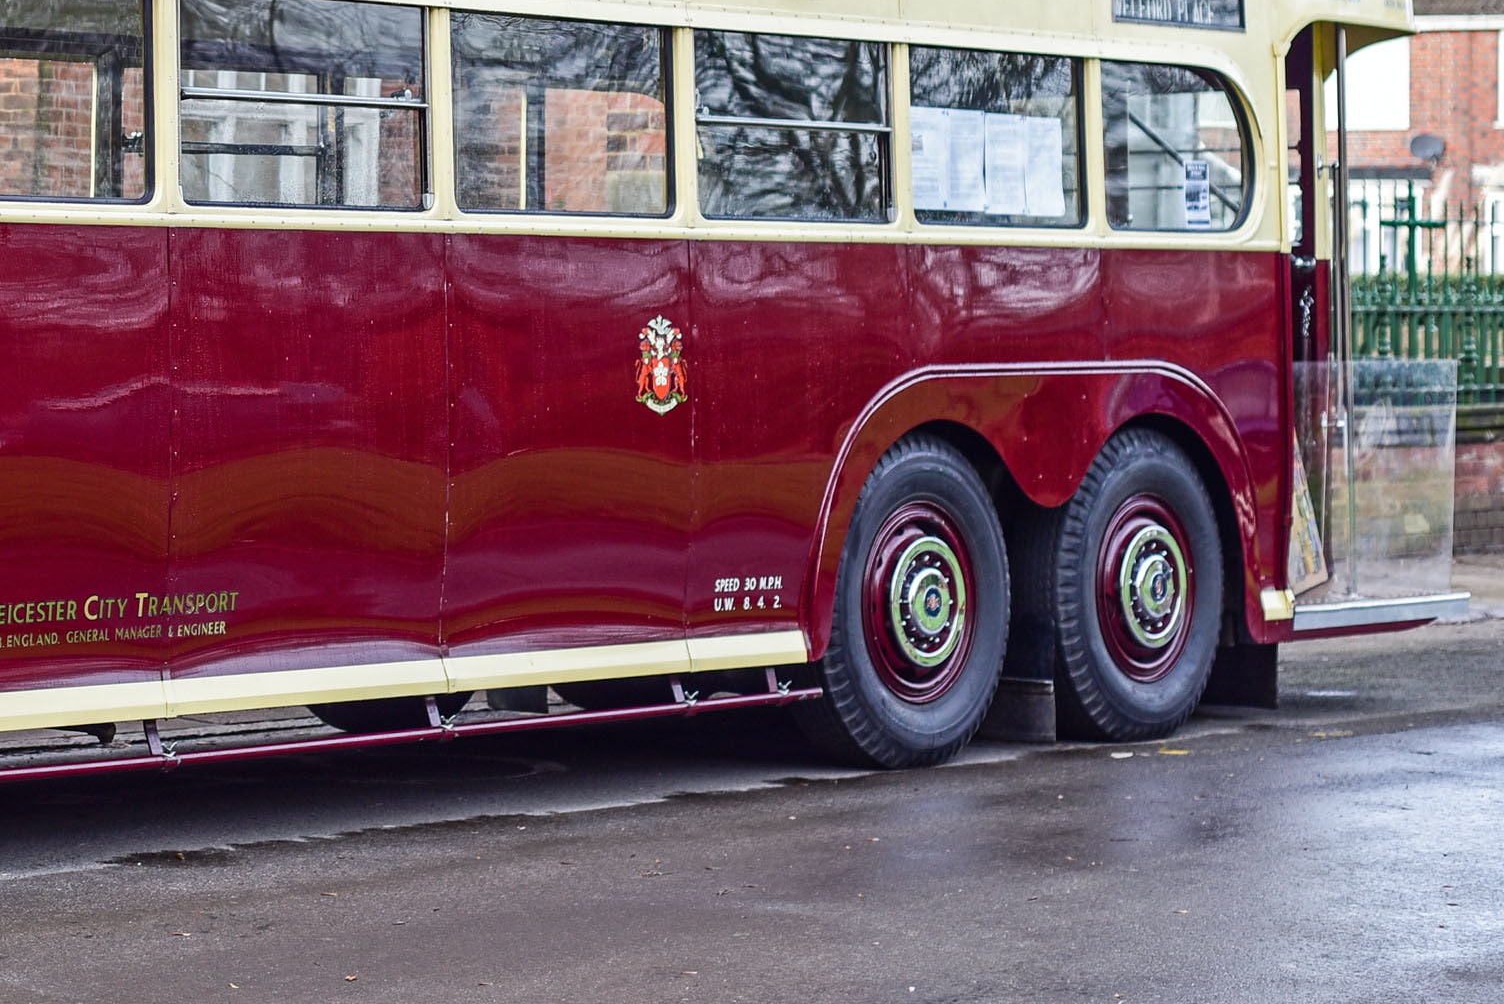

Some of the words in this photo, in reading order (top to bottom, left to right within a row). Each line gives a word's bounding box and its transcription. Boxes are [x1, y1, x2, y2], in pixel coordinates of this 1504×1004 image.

[714, 577, 740, 593] SPEED
[743, 576, 757, 591] 30
[66, 628, 110, 644] GENERAL
[115, 624, 162, 640] MANAGER
[167, 625, 174, 638] &
[177, 620, 227, 637] ENGINEER
